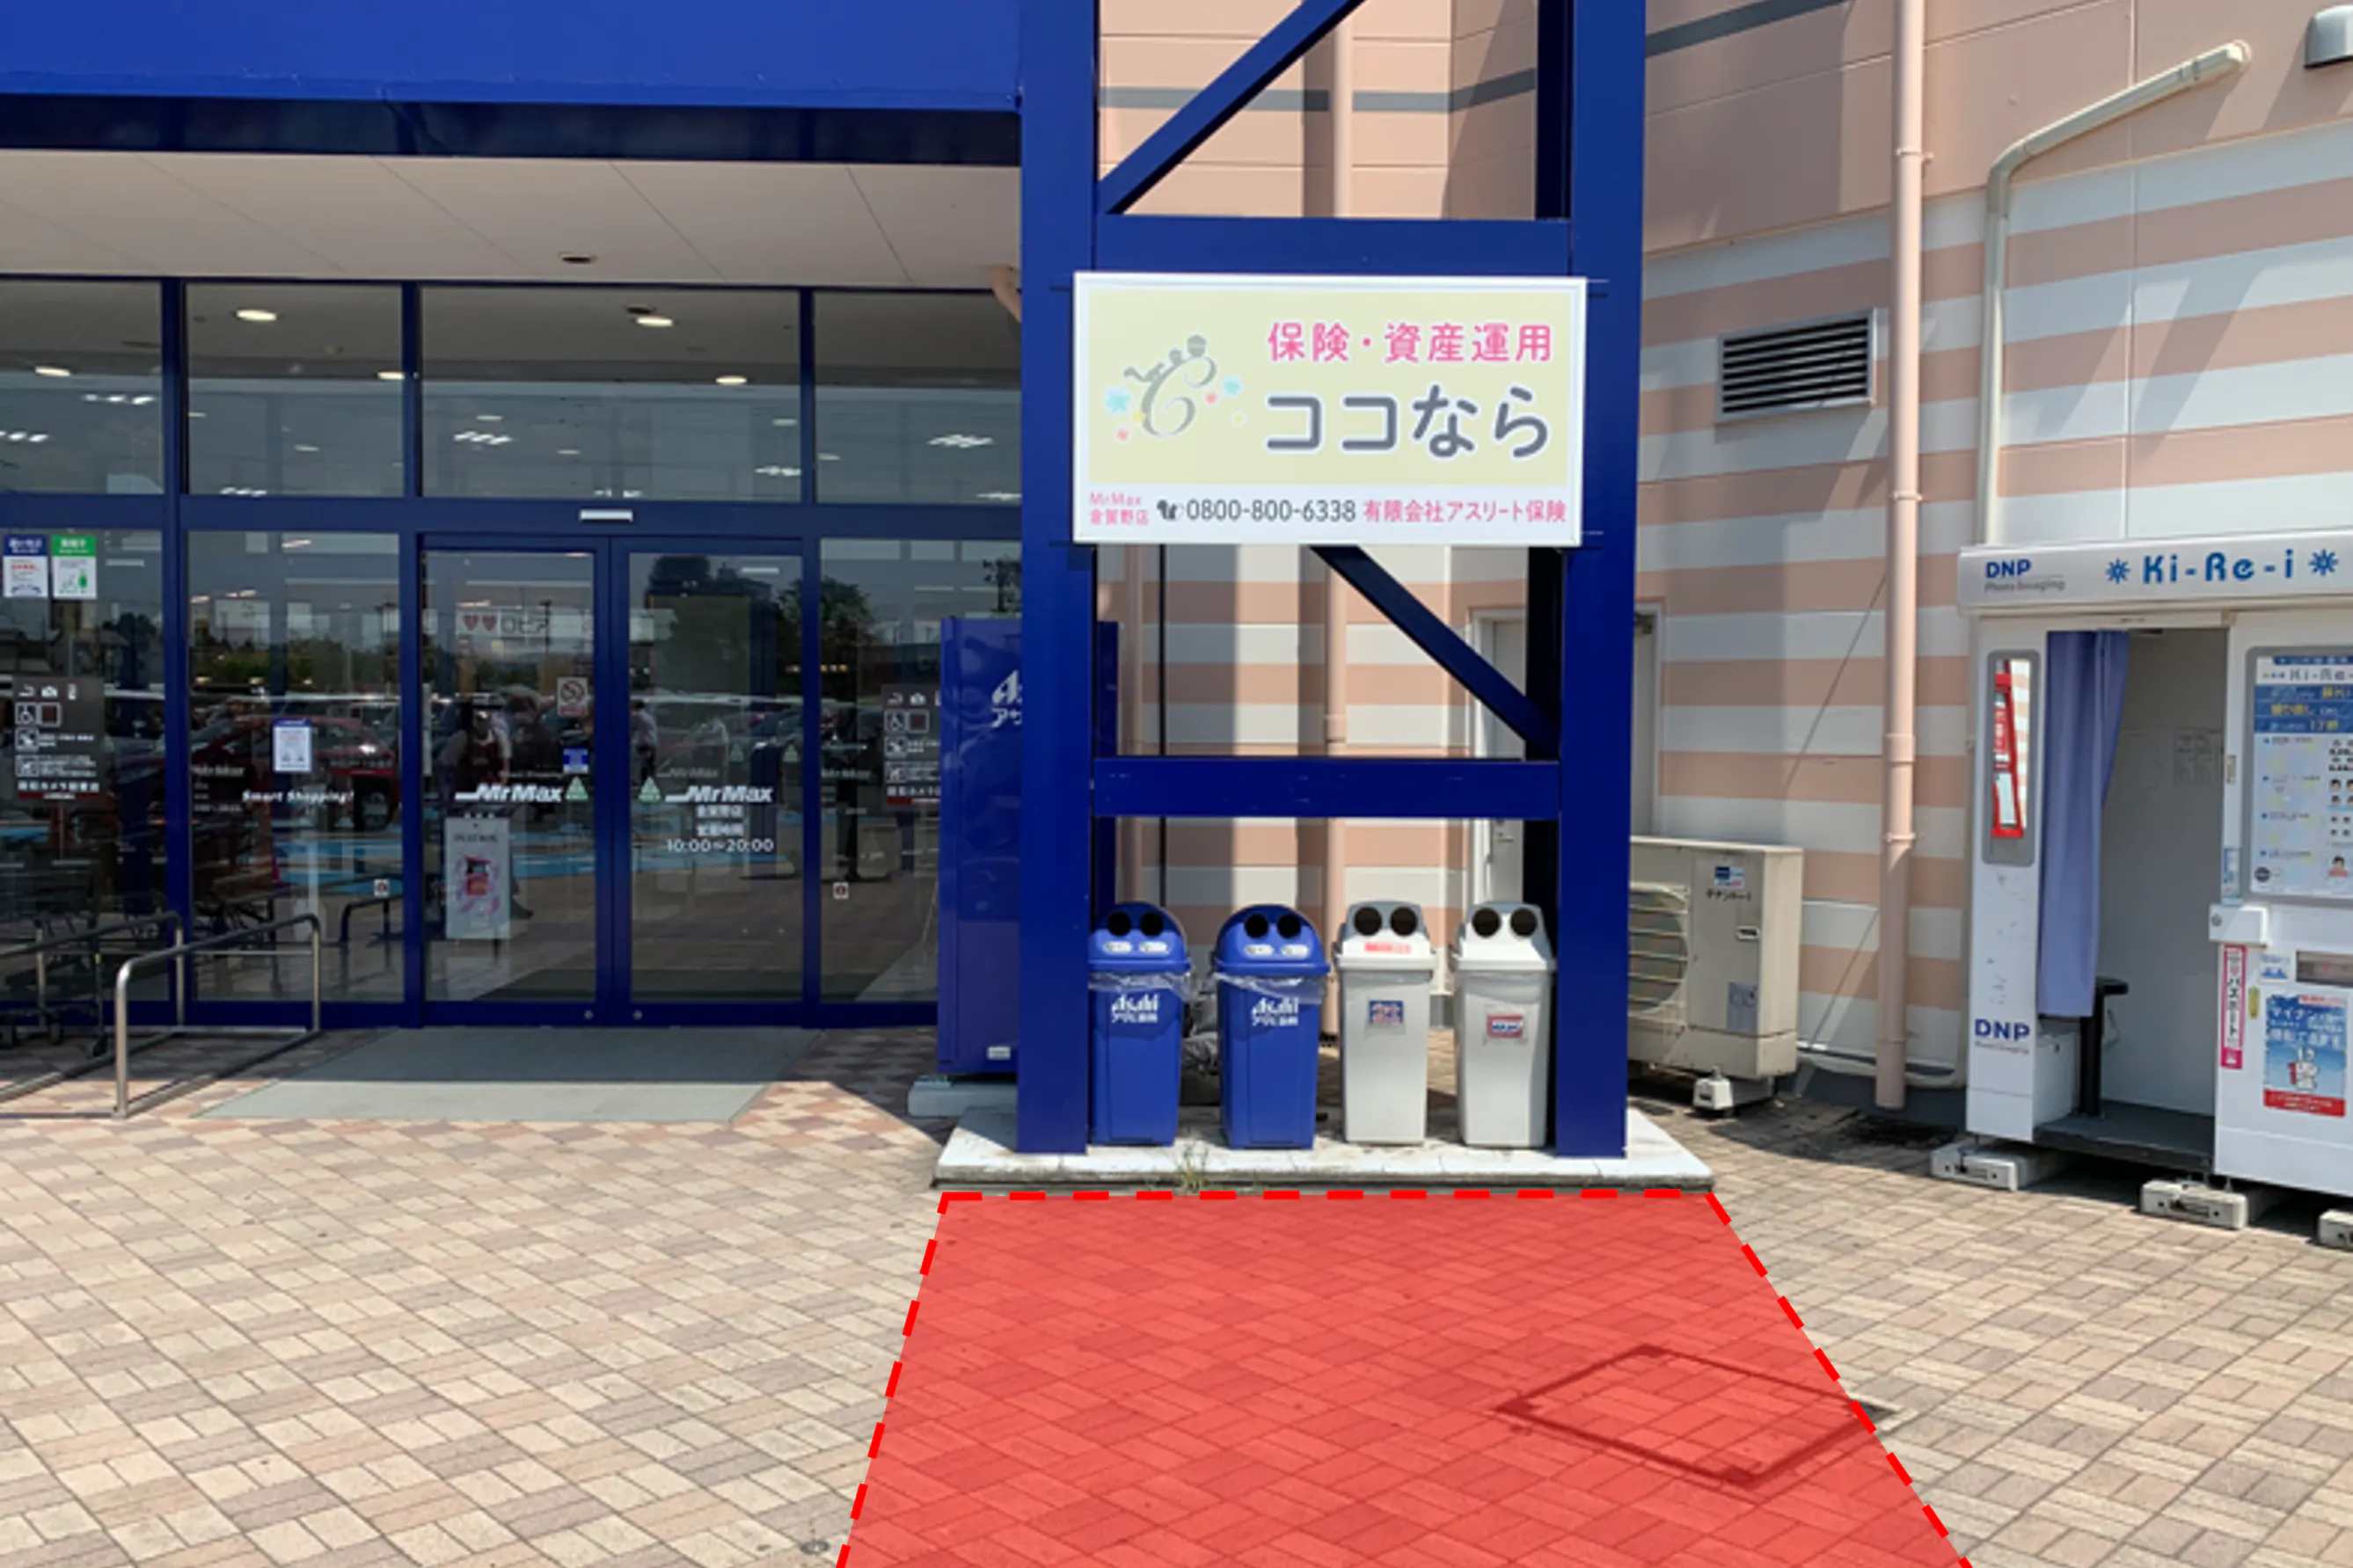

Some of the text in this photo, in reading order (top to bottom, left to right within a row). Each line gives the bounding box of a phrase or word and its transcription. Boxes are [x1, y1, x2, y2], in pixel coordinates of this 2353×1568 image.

[1268, 322, 1552, 363] 保険・資産運用
[1267, 385, 1549, 457] ココなら
[1187, 499, 1356, 522] 0800-800-6338
[1363, 500, 1567, 522] 有限会社アスリート保険
[1985, 559, 2032, 579] DNP
[2143, 549, 2294, 584] Ki-Re-i
[455, 783, 563, 802] MrMax
[665, 785, 773, 802] MrMax
[1975, 1018, 2030, 1042] DNP
